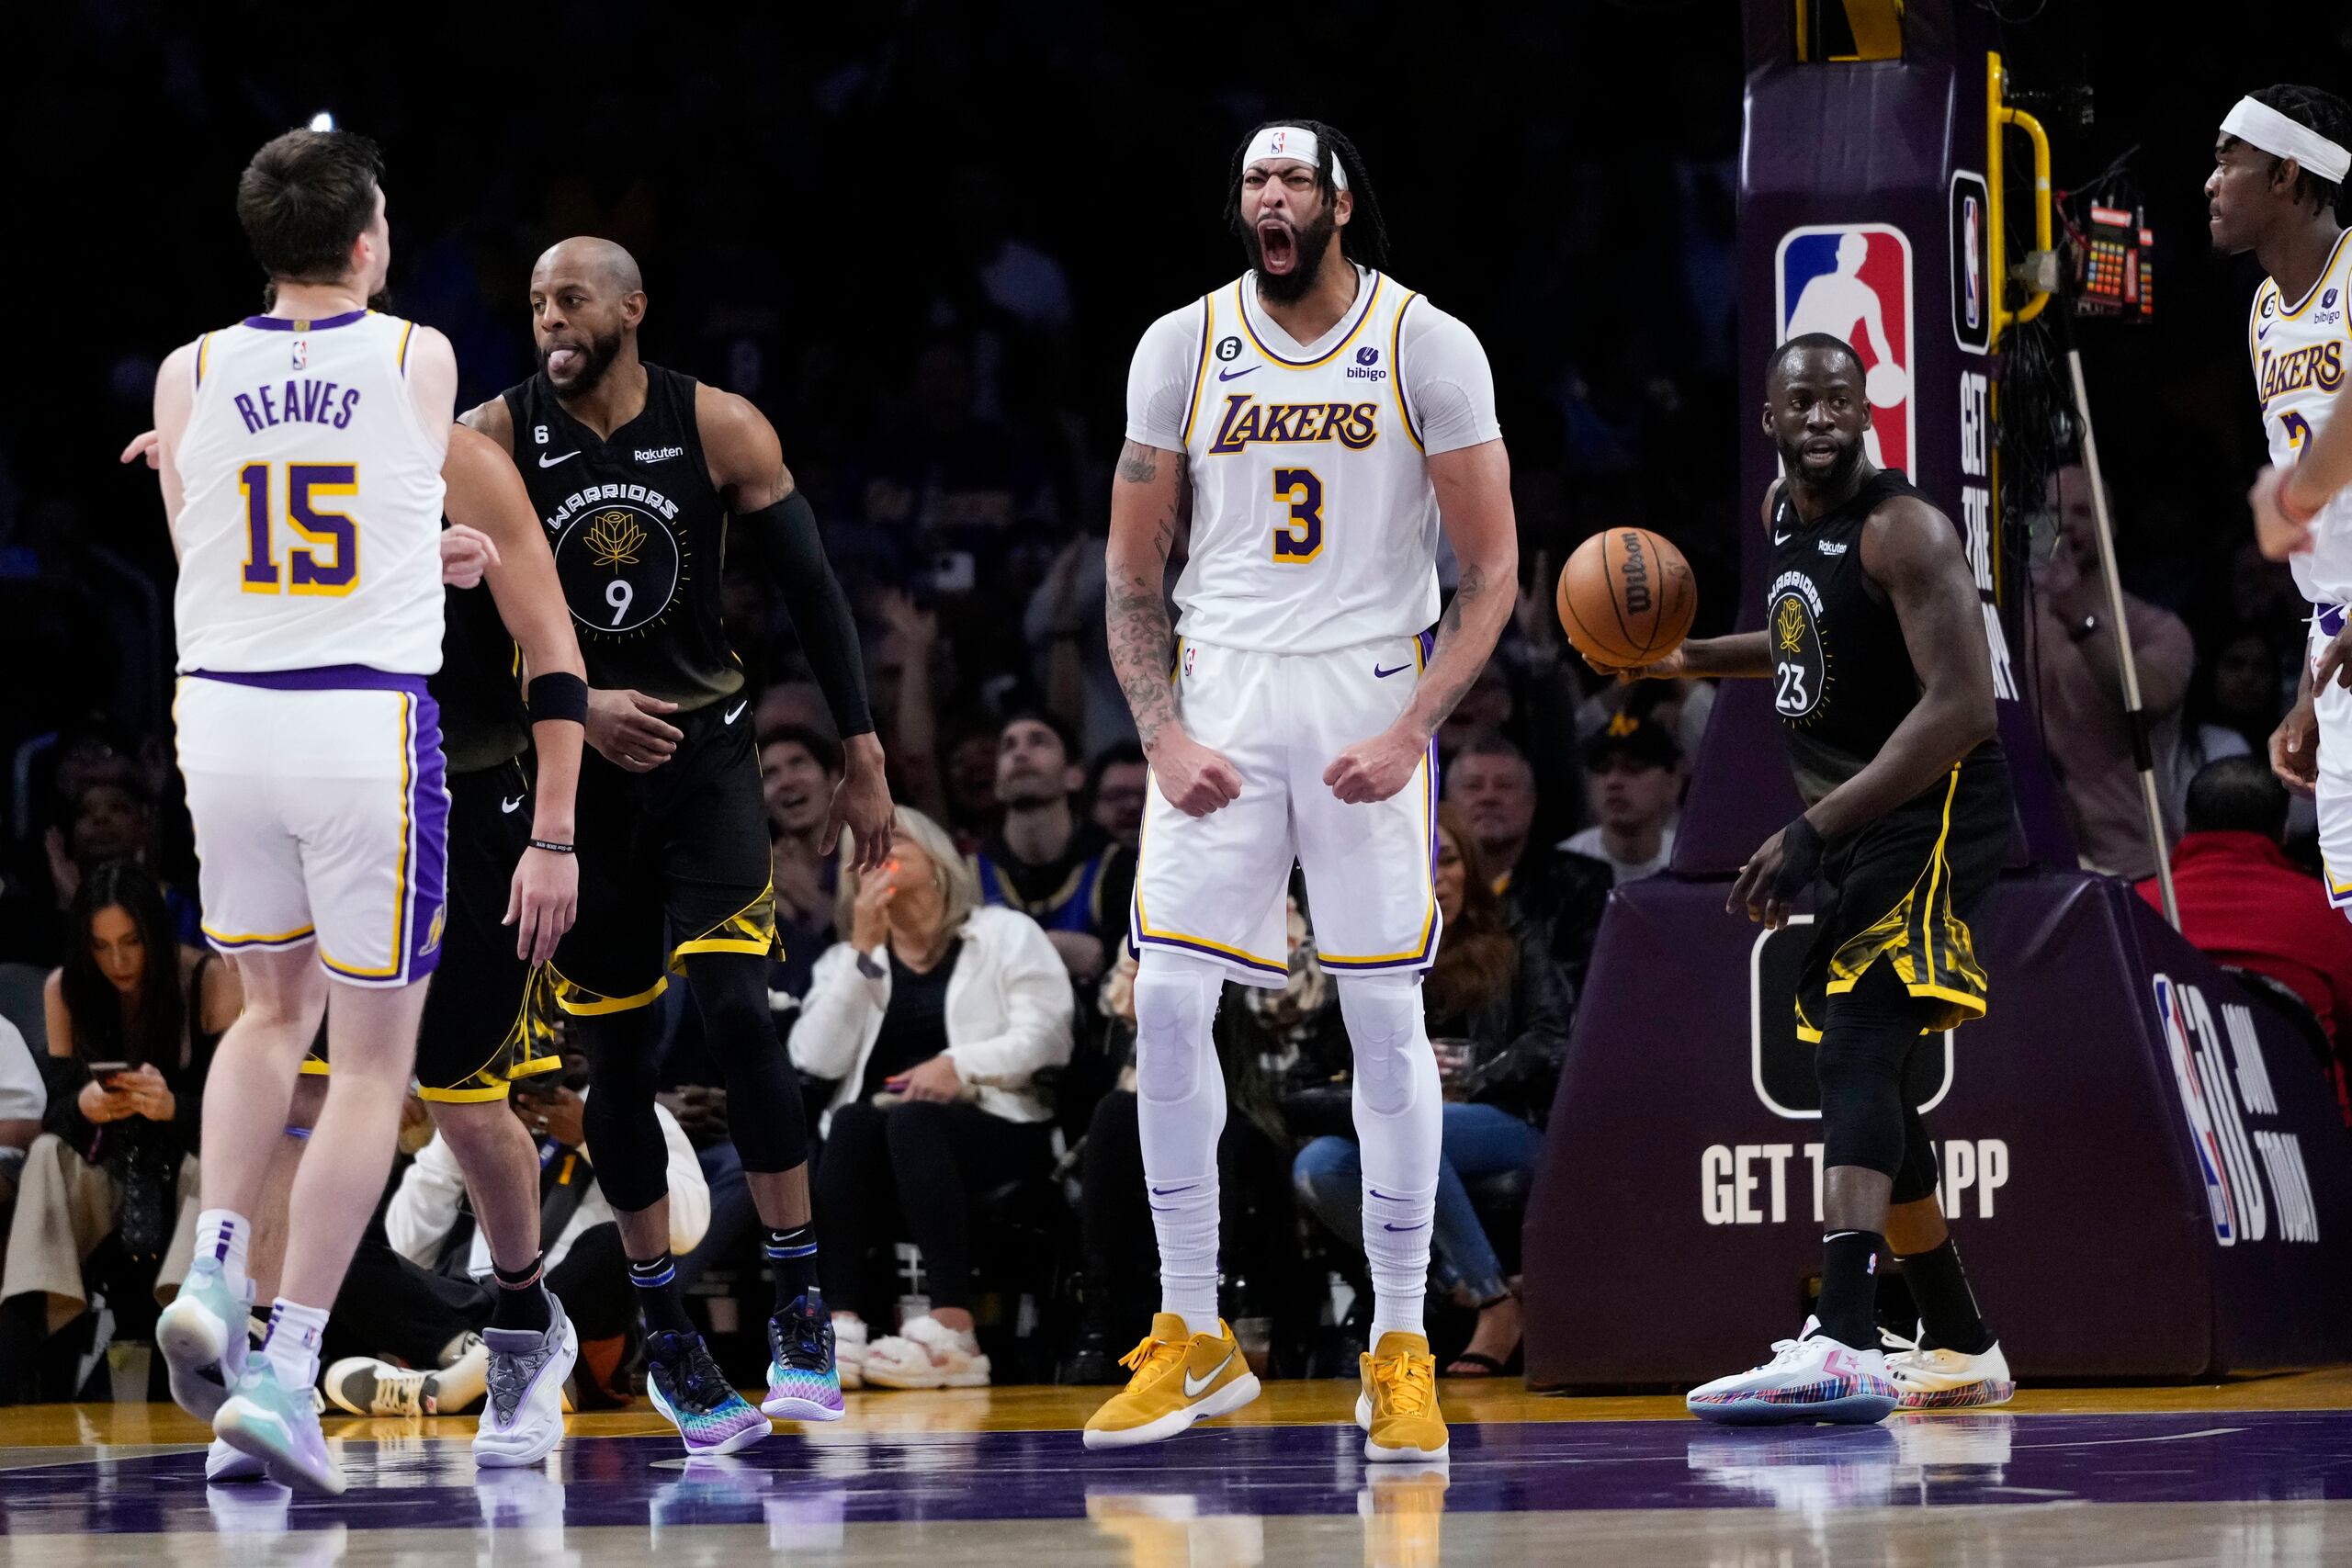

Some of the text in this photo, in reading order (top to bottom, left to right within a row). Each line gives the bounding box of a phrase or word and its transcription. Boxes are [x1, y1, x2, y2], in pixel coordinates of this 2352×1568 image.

[2313, 310, 2341, 324] bibigo
[1220, 339, 1237, 359] 6
[1346, 367, 1387, 382] bibigo
[2261, 340, 2345, 413] LAKERS
[234, 379, 361, 434] REAVES
[1207, 393, 1379, 456] LAKERS
[1960, 370, 1987, 477] GET
[534, 424, 549, 445] 6
[634, 446, 684, 462] Rakuten
[238, 461, 360, 598] 15
[547, 484, 680, 531] WARRIORS
[1272, 467, 1324, 564] 3
[1818, 540, 1848, 555] Rakuten
[605, 580, 634, 626] 9
[1768, 570, 1824, 618] WARRIORS
[1775, 661, 1808, 710] 23
[1702, 1144, 1793, 1225] GET
